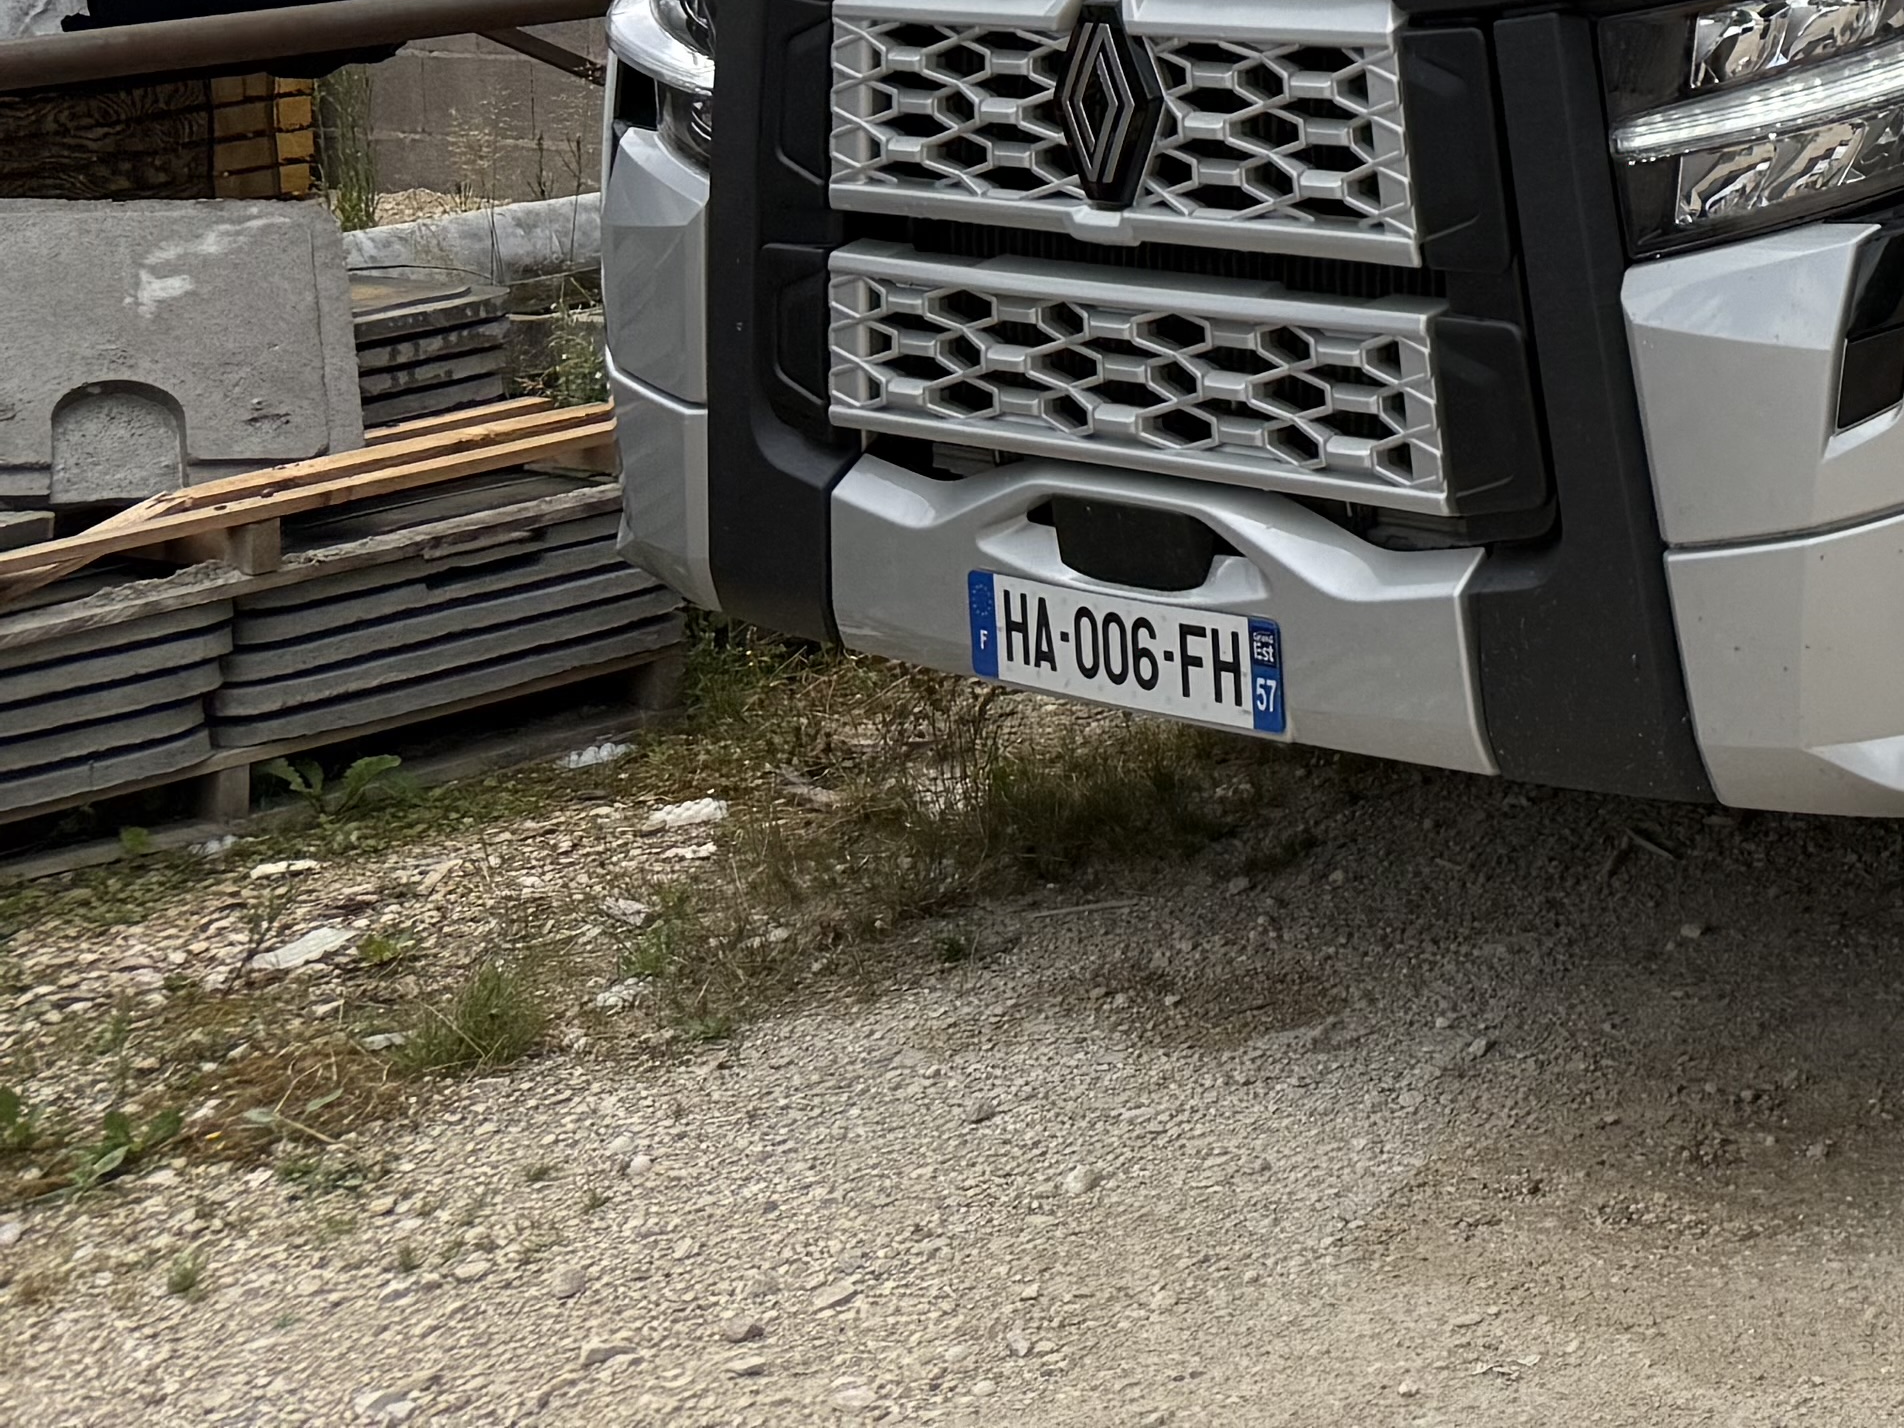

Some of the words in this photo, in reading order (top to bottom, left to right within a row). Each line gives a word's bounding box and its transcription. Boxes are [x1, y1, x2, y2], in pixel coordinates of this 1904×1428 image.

[979, 629, 988, 650] F
[1003, 589, 1243, 707] HA-006-FH
[1253, 641, 1275, 662] Est
[1256, 677, 1277, 712] 57
